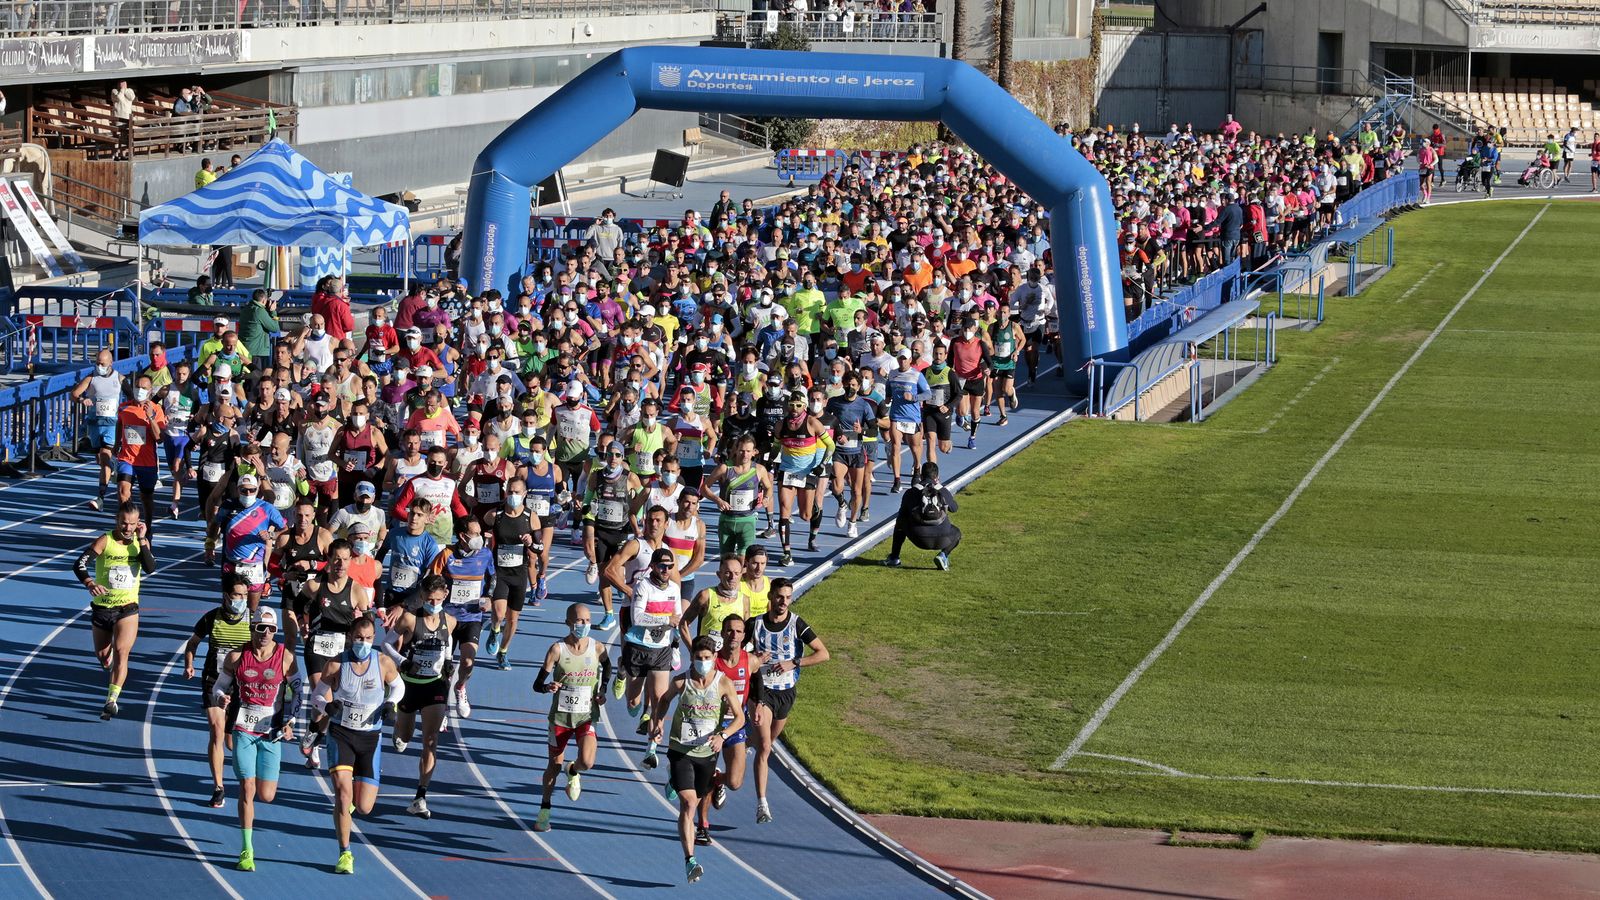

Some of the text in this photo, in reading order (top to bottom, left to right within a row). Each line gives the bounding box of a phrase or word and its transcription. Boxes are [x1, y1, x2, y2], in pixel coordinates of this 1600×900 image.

[1, 49, 25, 66] CALIDAD
[687, 68, 916, 87] Ayuntamiento de Jerez
[687, 80, 754, 91] Deportes
[1078, 246, 1096, 330] deportes@aytojerez.es
[602, 508, 613, 516] 502
[114, 573, 128, 583] 427
[394, 572, 407, 580] 551
[456, 589, 471, 598] 535
[650, 628, 663, 638] 637
[320, 638, 334, 649] 586
[564, 695, 579, 705] 362
[243, 714, 259, 725] 369
[348, 713, 363, 722] 421
[688, 727, 702, 738] 391
